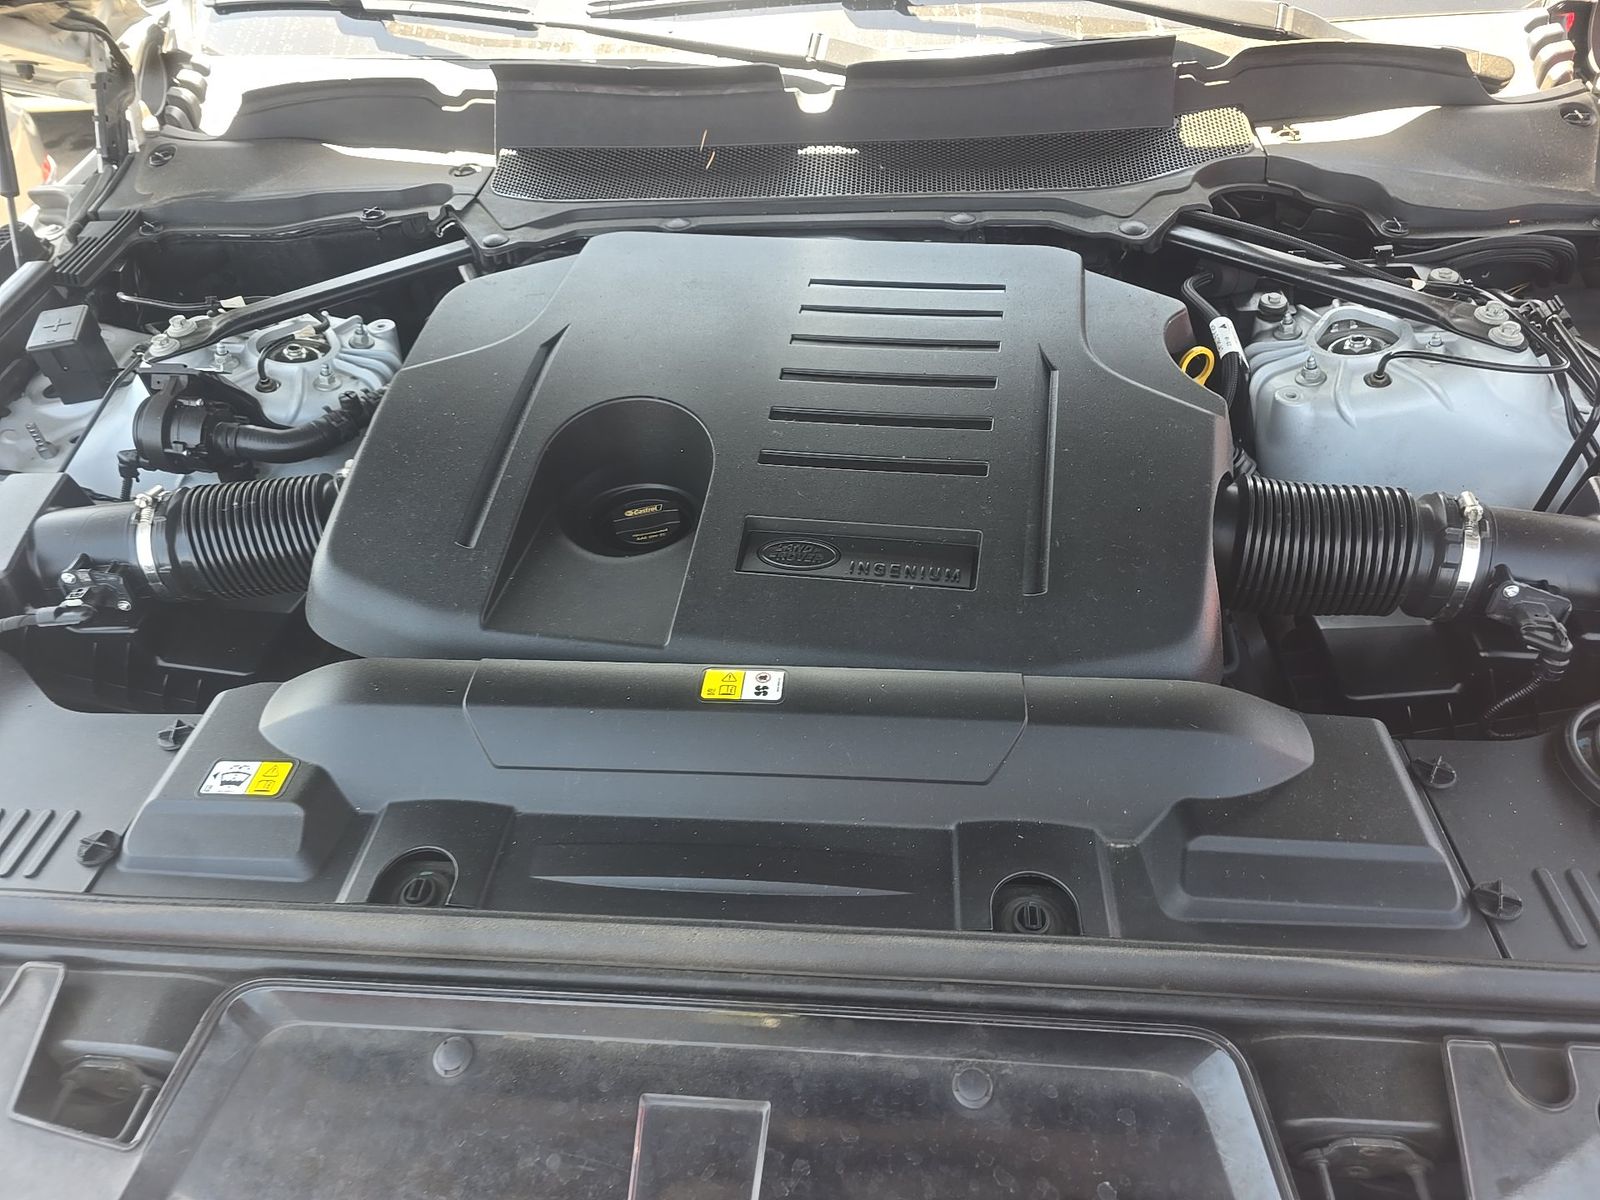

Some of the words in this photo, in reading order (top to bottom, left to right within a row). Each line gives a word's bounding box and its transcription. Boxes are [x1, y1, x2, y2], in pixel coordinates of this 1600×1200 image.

[776, 544, 814, 553] LAND
[777, 552, 824, 563] ROVER
[849, 560, 962, 583] INGENIUM
